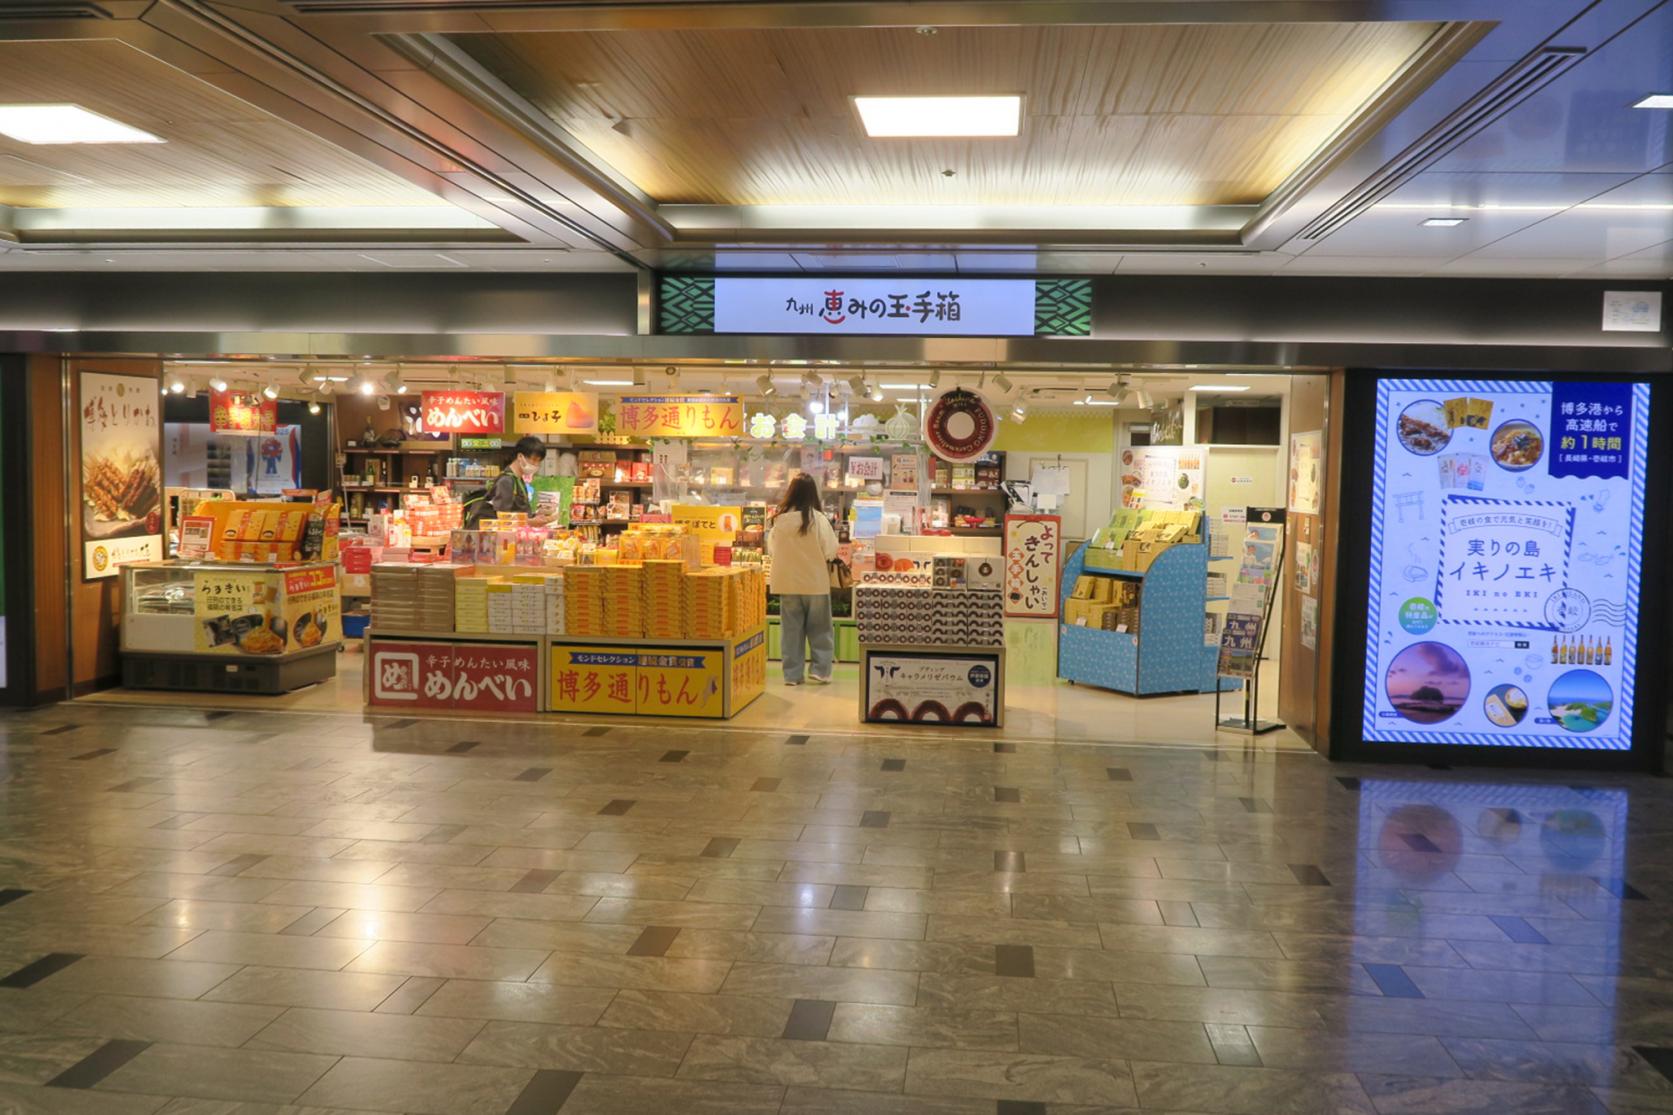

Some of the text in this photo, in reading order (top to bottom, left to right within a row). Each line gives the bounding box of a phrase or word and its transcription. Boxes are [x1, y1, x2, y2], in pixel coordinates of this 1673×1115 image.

[785, 289, 961, 324] 九州恵みの玉手箱
[426, 406, 500, 428] めんべい
[620, 403, 739, 430] 博多通りもん
[1561, 402, 1623, 416] 博多港から
[1565, 419, 1619, 432] 高速船で
[1561, 434, 1621, 450] 約1時間
[1040, 525, 1054, 564] よって
[1467, 539, 1540, 557] 実りの島
[1024, 535, 1040, 609] きんしゃい
[1449, 561, 1556, 582] イキノエキ
[1224, 635, 1253, 649] 九州
[426, 655, 531, 671] 辛子めんたい風味
[424, 670, 532, 700] めんべい
[557, 669, 698, 705] 博多通りもん
